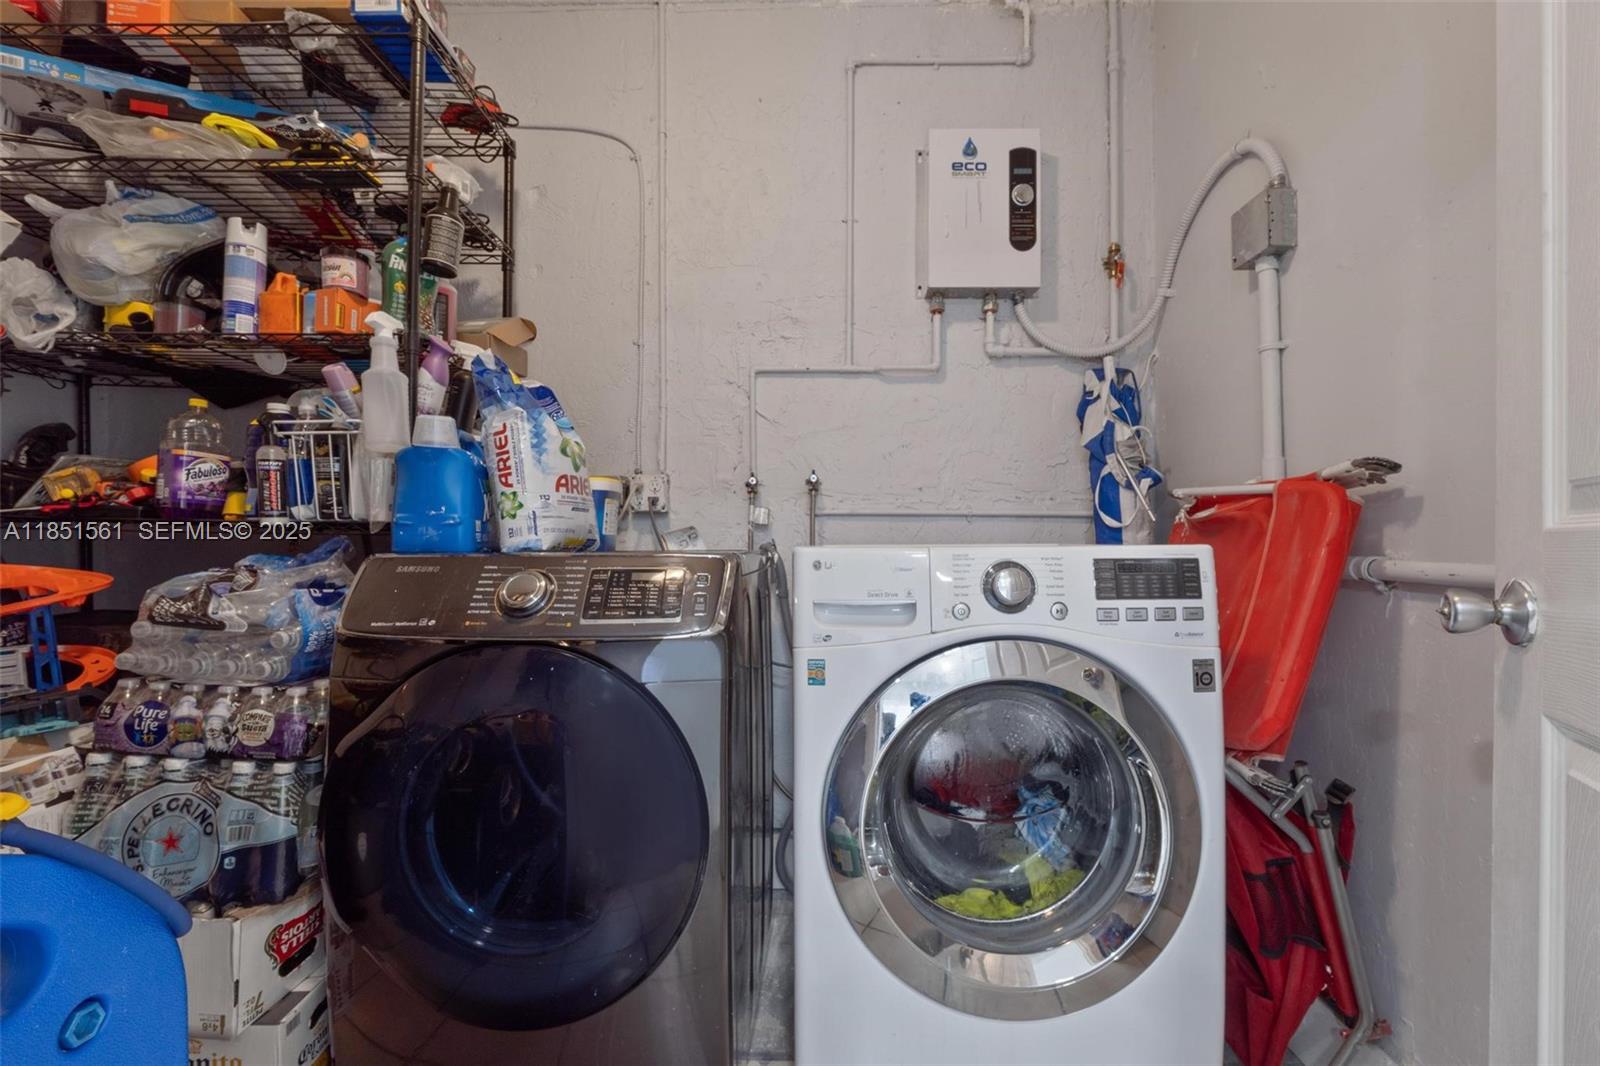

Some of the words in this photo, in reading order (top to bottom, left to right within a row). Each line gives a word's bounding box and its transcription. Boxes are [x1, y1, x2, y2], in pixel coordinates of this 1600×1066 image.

[952, 162, 987, 171] eco
[493, 422, 514, 488] ARIEL
[184, 465, 227, 481] Fabuloso
[555, 474, 592, 497] ARIE
[395, 565, 441, 573] SAMSUNG
[133, 705, 169, 720] Pure
[133, 718, 159, 732] Life
[281, 918, 320, 955] STELLA
